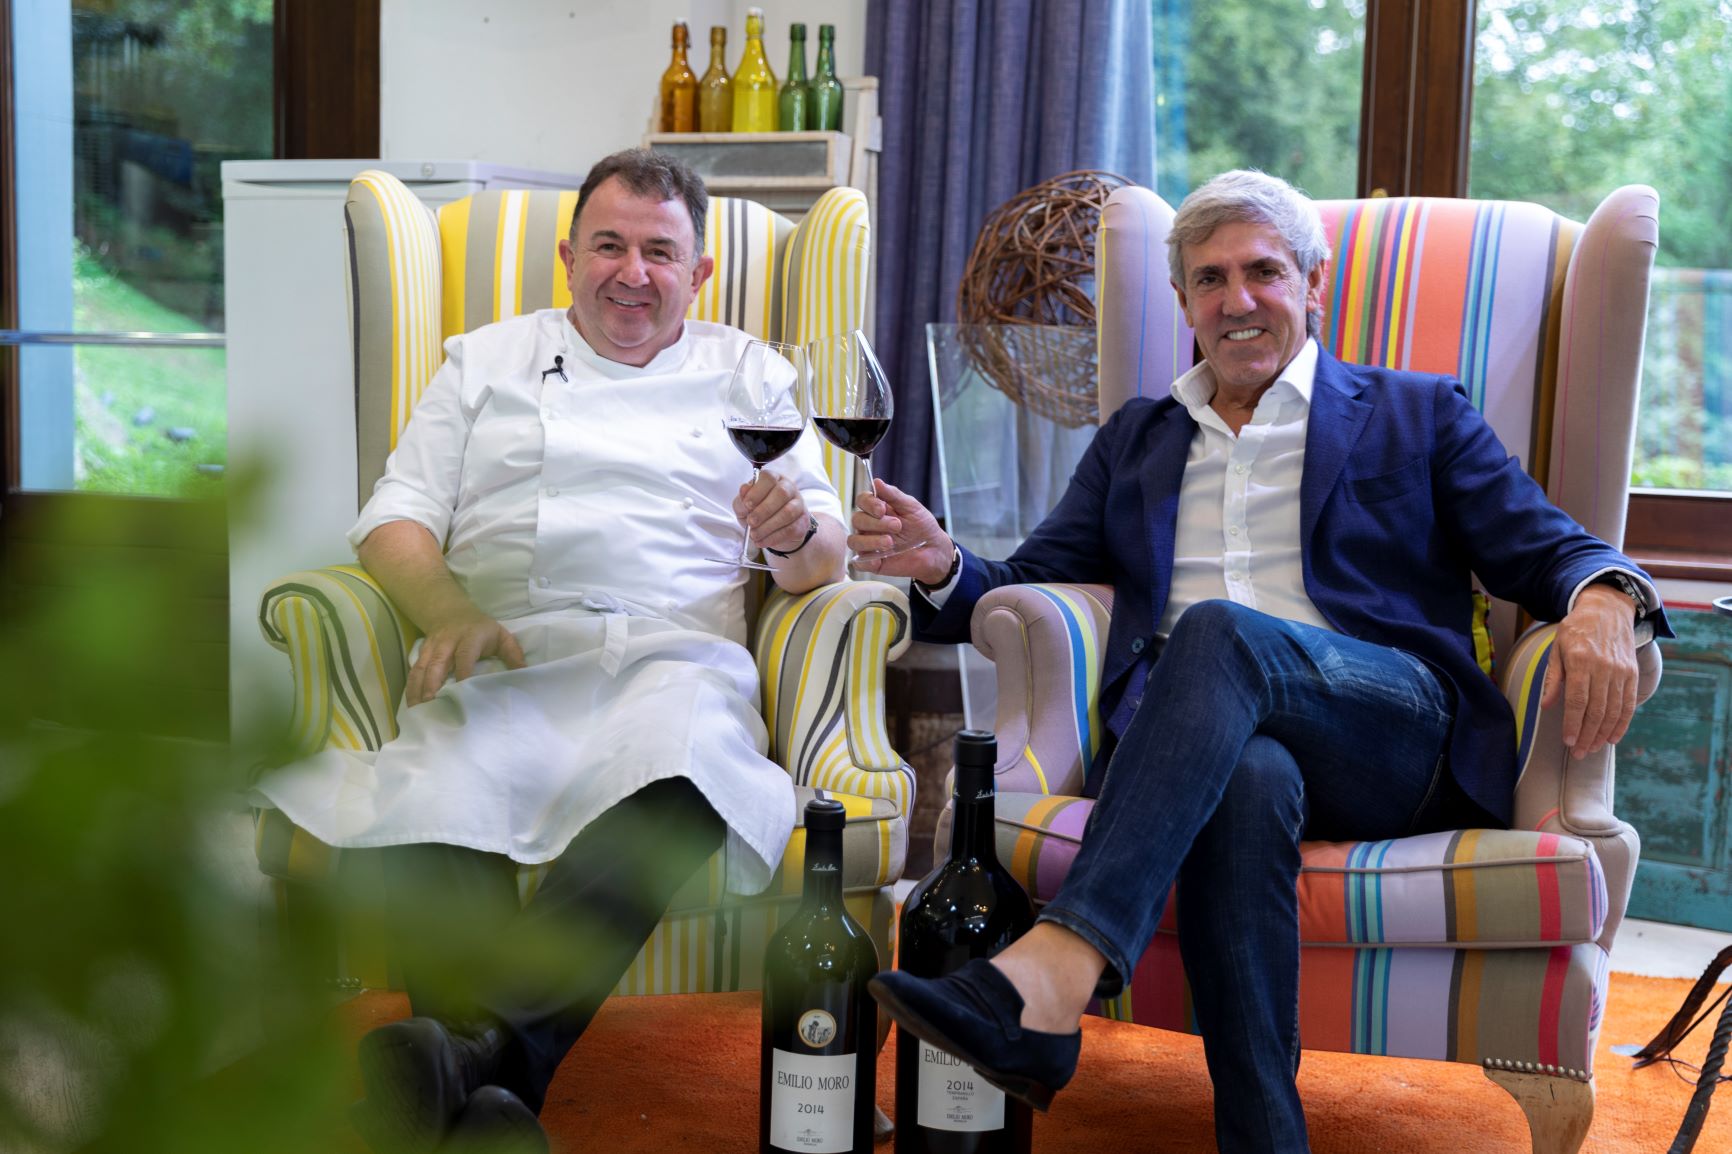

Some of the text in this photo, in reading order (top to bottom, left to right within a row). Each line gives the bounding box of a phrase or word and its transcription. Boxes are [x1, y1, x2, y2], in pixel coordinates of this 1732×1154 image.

[924, 1048, 961, 1067] EMILIO
[777, 1070, 850, 1091] EMILIO MORO
[946, 1080, 974, 1091] 2014
[797, 1103, 825, 1115] 2014
